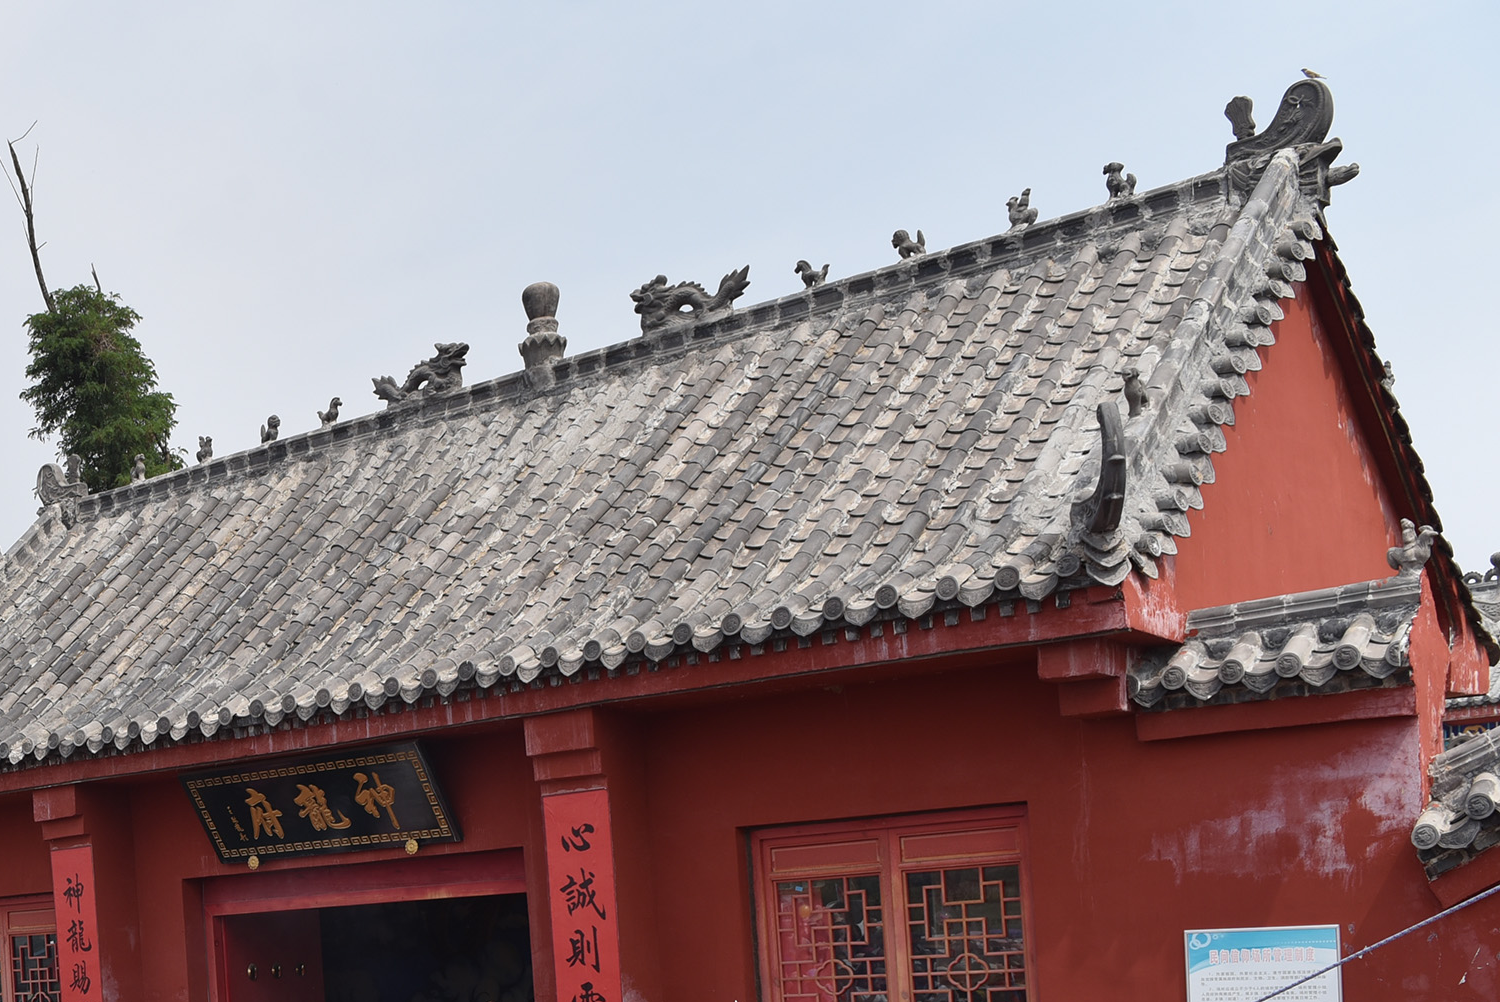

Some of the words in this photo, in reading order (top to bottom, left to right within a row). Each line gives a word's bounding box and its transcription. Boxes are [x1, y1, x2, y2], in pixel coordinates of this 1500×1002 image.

[1209, 946, 1315, 964] 民间信仰场所管理制度
